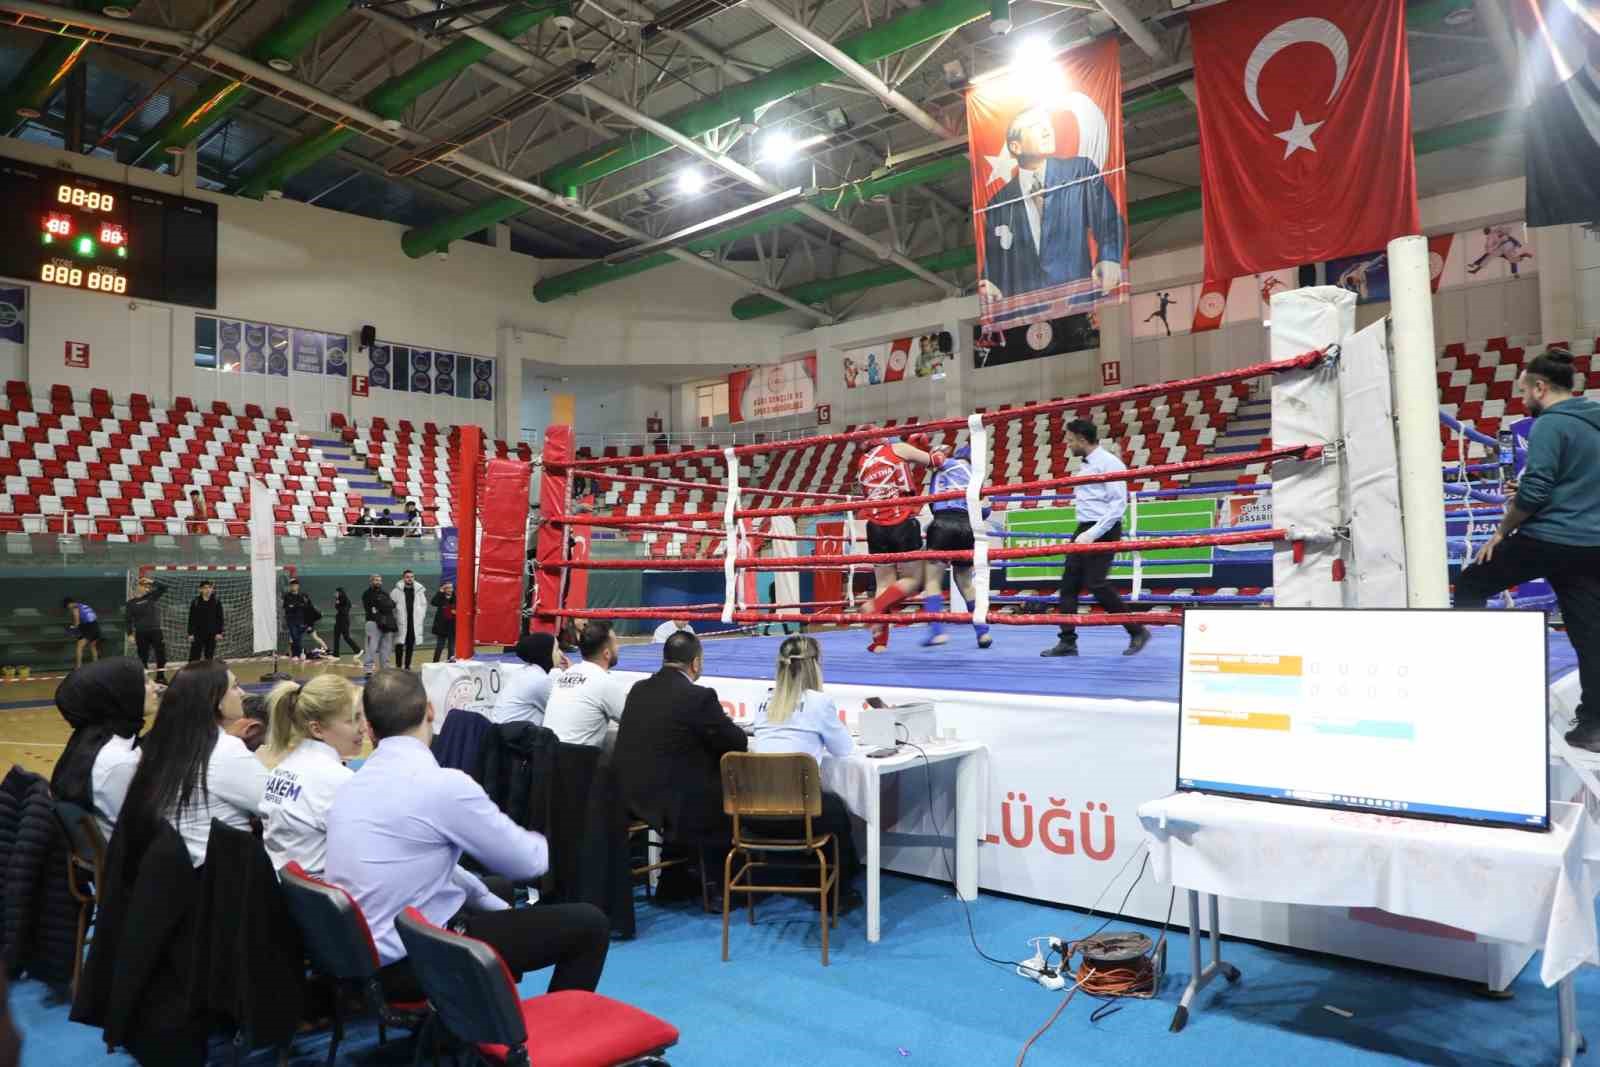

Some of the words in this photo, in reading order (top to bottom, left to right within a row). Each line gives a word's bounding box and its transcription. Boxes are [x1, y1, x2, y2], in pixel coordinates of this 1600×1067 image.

[58, 185, 114, 212] 88:88
[41, 264, 82, 286] 888
[88, 272, 126, 293] 888
[71, 343, 85, 362] E
[1105, 363, 1118, 380] H
[356, 376, 366, 392] F
[820, 406, 829, 421] G
[266, 776, 302, 802] AKEM
[986, 791, 1116, 861] ÜĞÜ
